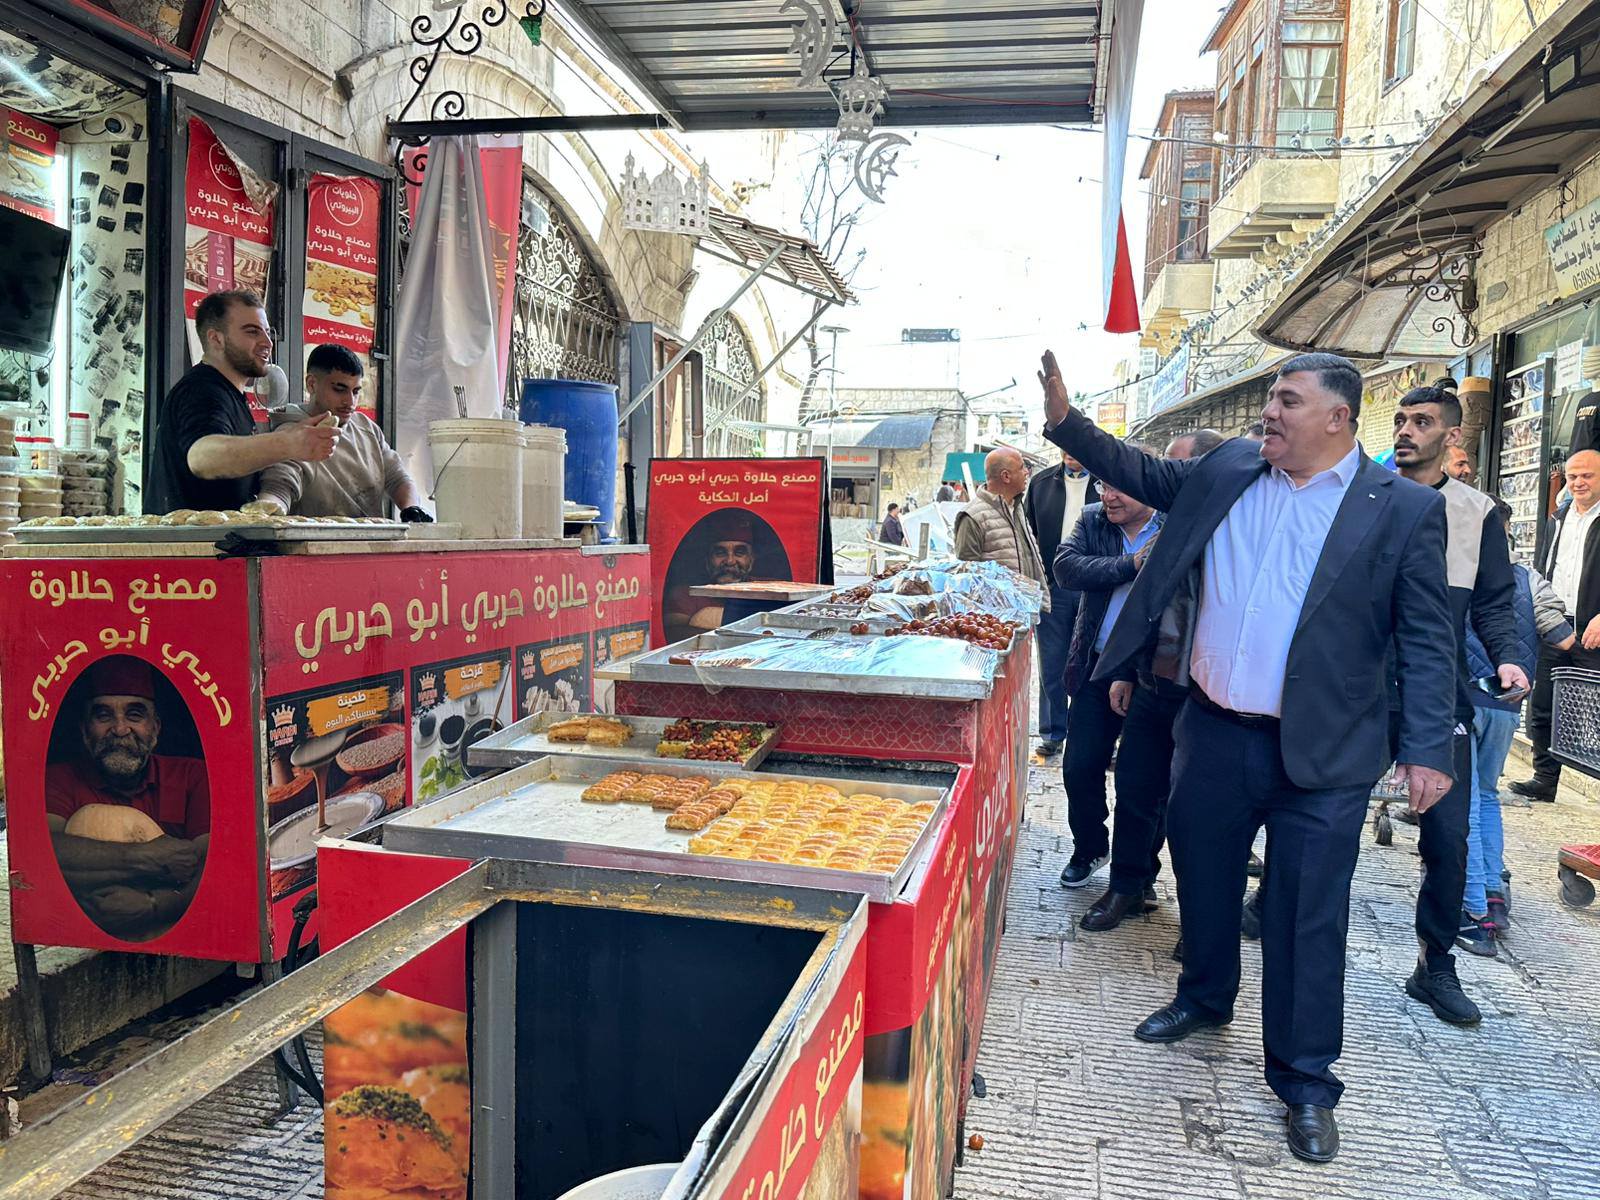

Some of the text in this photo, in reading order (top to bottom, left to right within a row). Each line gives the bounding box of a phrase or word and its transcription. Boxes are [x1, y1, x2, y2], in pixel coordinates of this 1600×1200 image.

[6, 120, 47, 143] مصنع
[198, 189, 228, 207] حلاوة
[332, 186, 357, 201] حلويات
[329, 200, 360, 215] البيروتي
[188, 205, 269, 235] حربي أبو حربي
[314, 224, 371, 249] مصنع حلاوة
[306, 239, 377, 265] حربي أبو حربي
[355, 333, 373, 345] حلاوة
[654, 469, 817, 487] مصنع حلاوة حربي أبو حربي
[698, 489, 769, 505] أصل الحكاية
[29, 570, 217, 614] مصنع حلاوة
[294, 569, 640, 675] مصنع حلاوة حربي أبو حربي
[28, 616, 232, 727] حربي أبو حربي
[337, 692, 367, 707] طحينة
[741, 990, 863, 1200] مصنع حلاو
